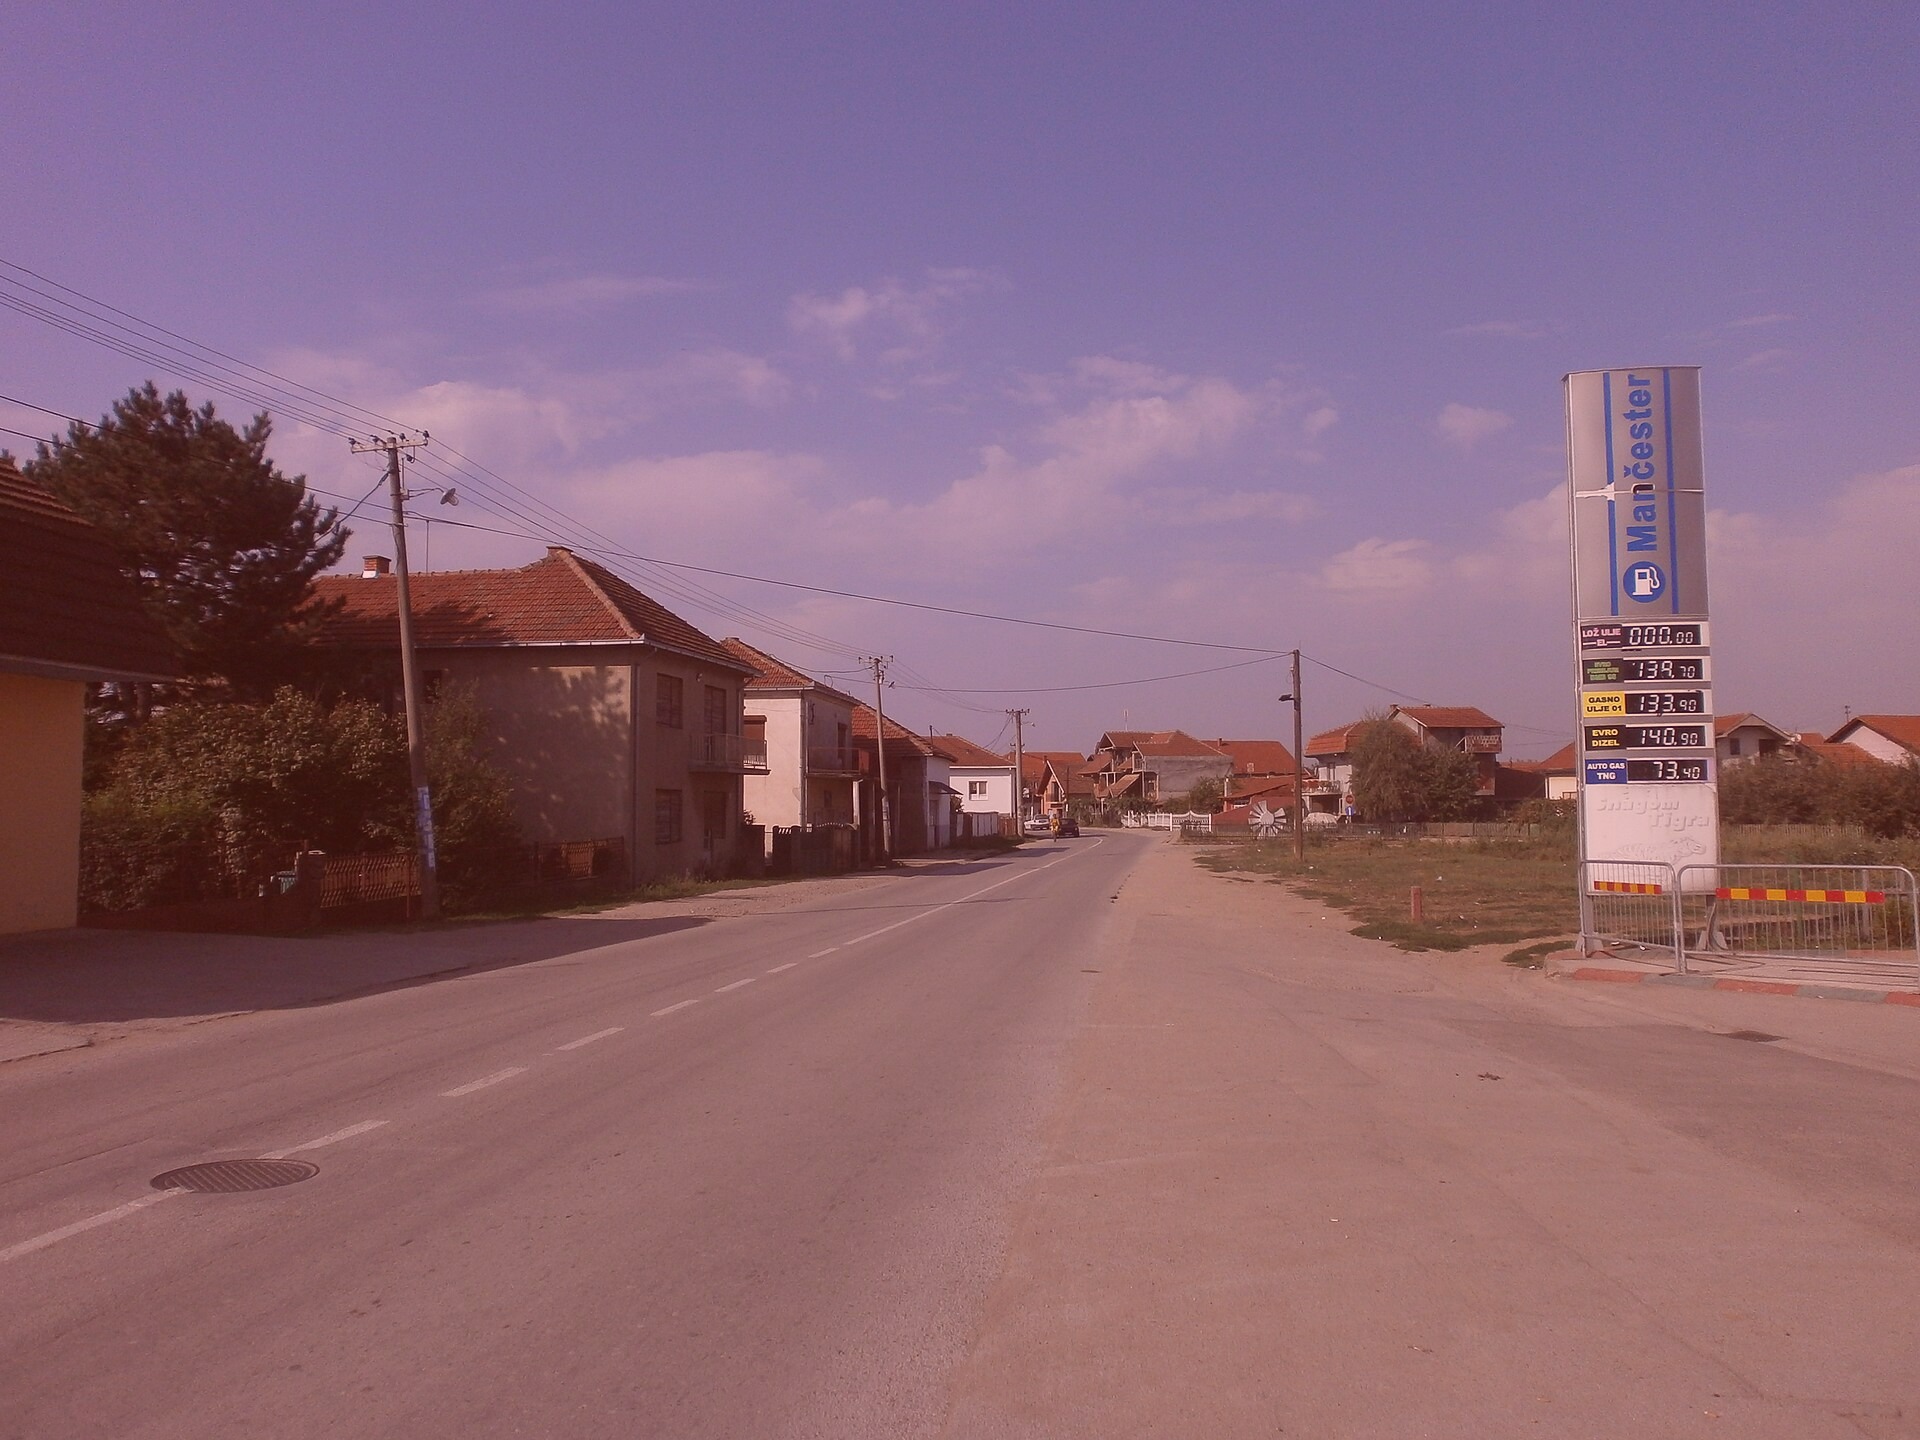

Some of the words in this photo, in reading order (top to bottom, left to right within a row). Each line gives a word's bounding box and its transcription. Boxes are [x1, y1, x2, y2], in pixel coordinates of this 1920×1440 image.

[1623, 373, 1657, 552] Mančester
[1582, 627, 1600, 638] LOŽ
[1601, 628, 1621, 636] ULJE
[1592, 739, 1620, 747] DIZEL
[1596, 772, 1616, 780] TNG
